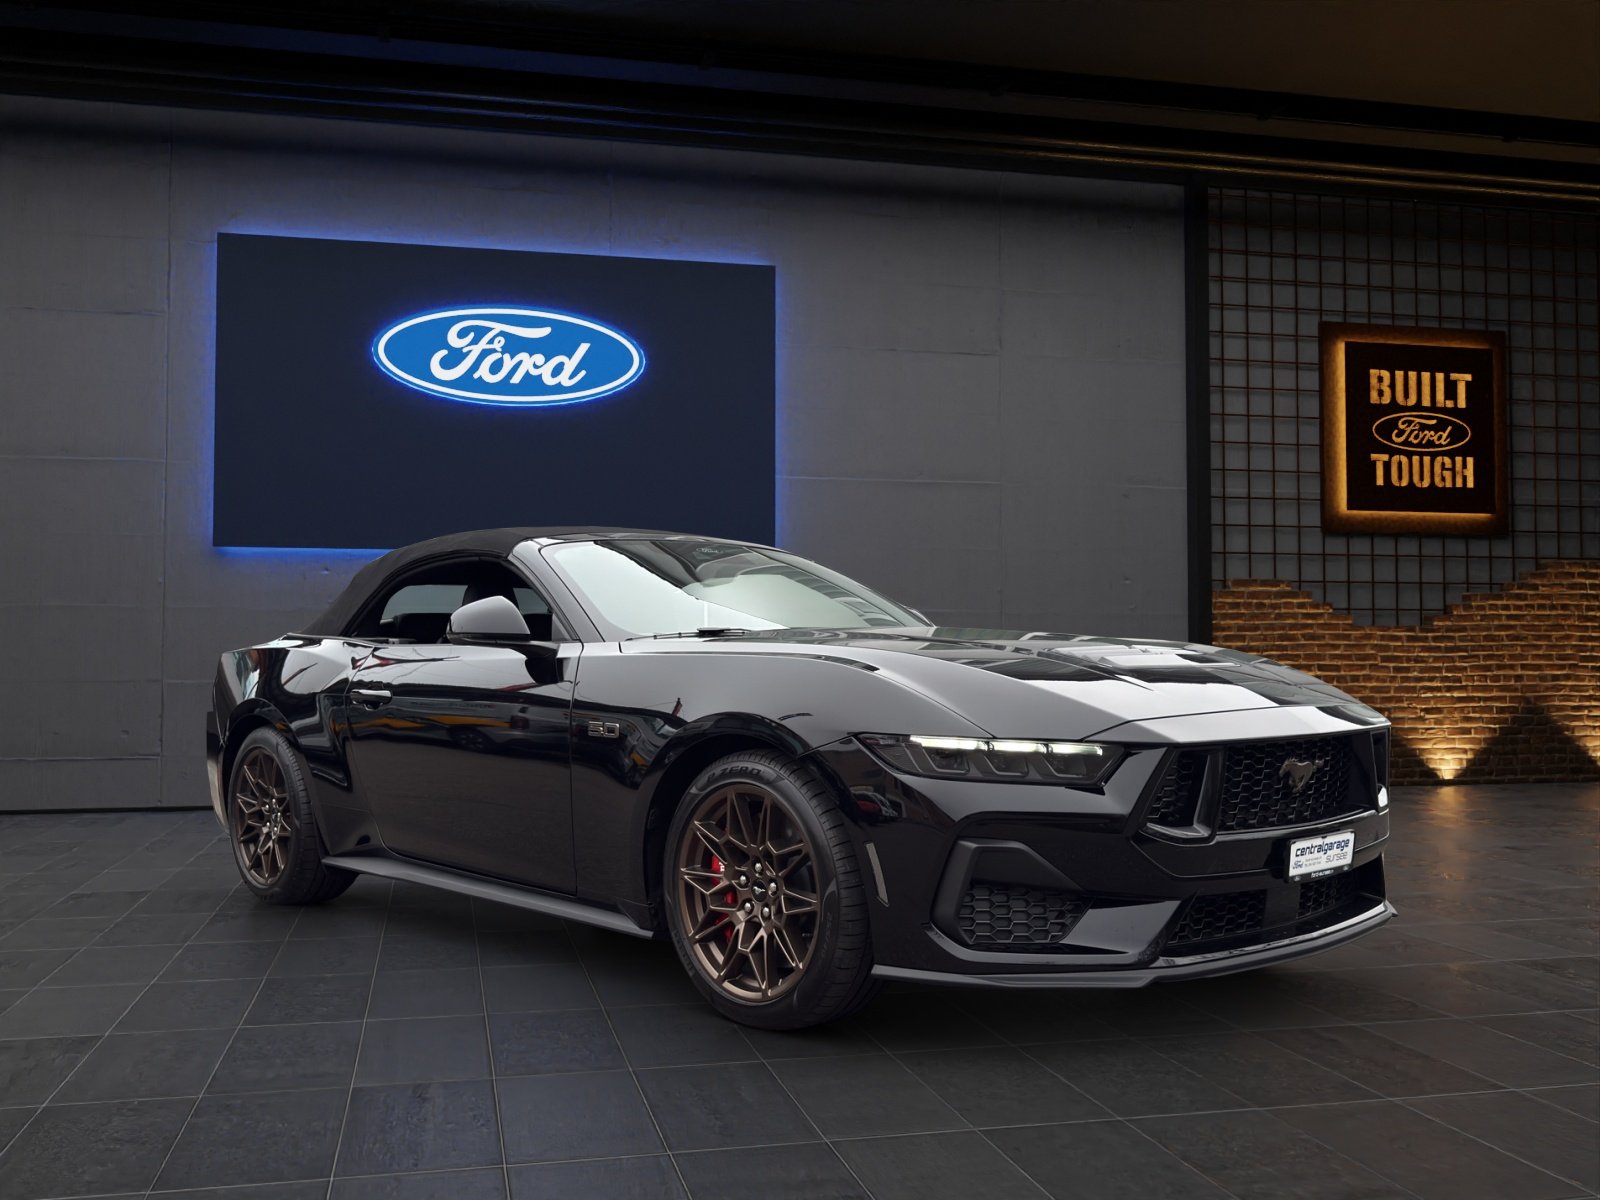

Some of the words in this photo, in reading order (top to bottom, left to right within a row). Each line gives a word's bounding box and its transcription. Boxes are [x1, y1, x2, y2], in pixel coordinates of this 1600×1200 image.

[430, 319, 591, 387] Ford
[1369, 369, 1473, 409] BUILT
[1391, 416, 1453, 445] Ford
[1370, 453, 1475, 489] TOUGH
[719, 765, 762, 776] ZERO
[1295, 838, 1350, 857] centralgarage
